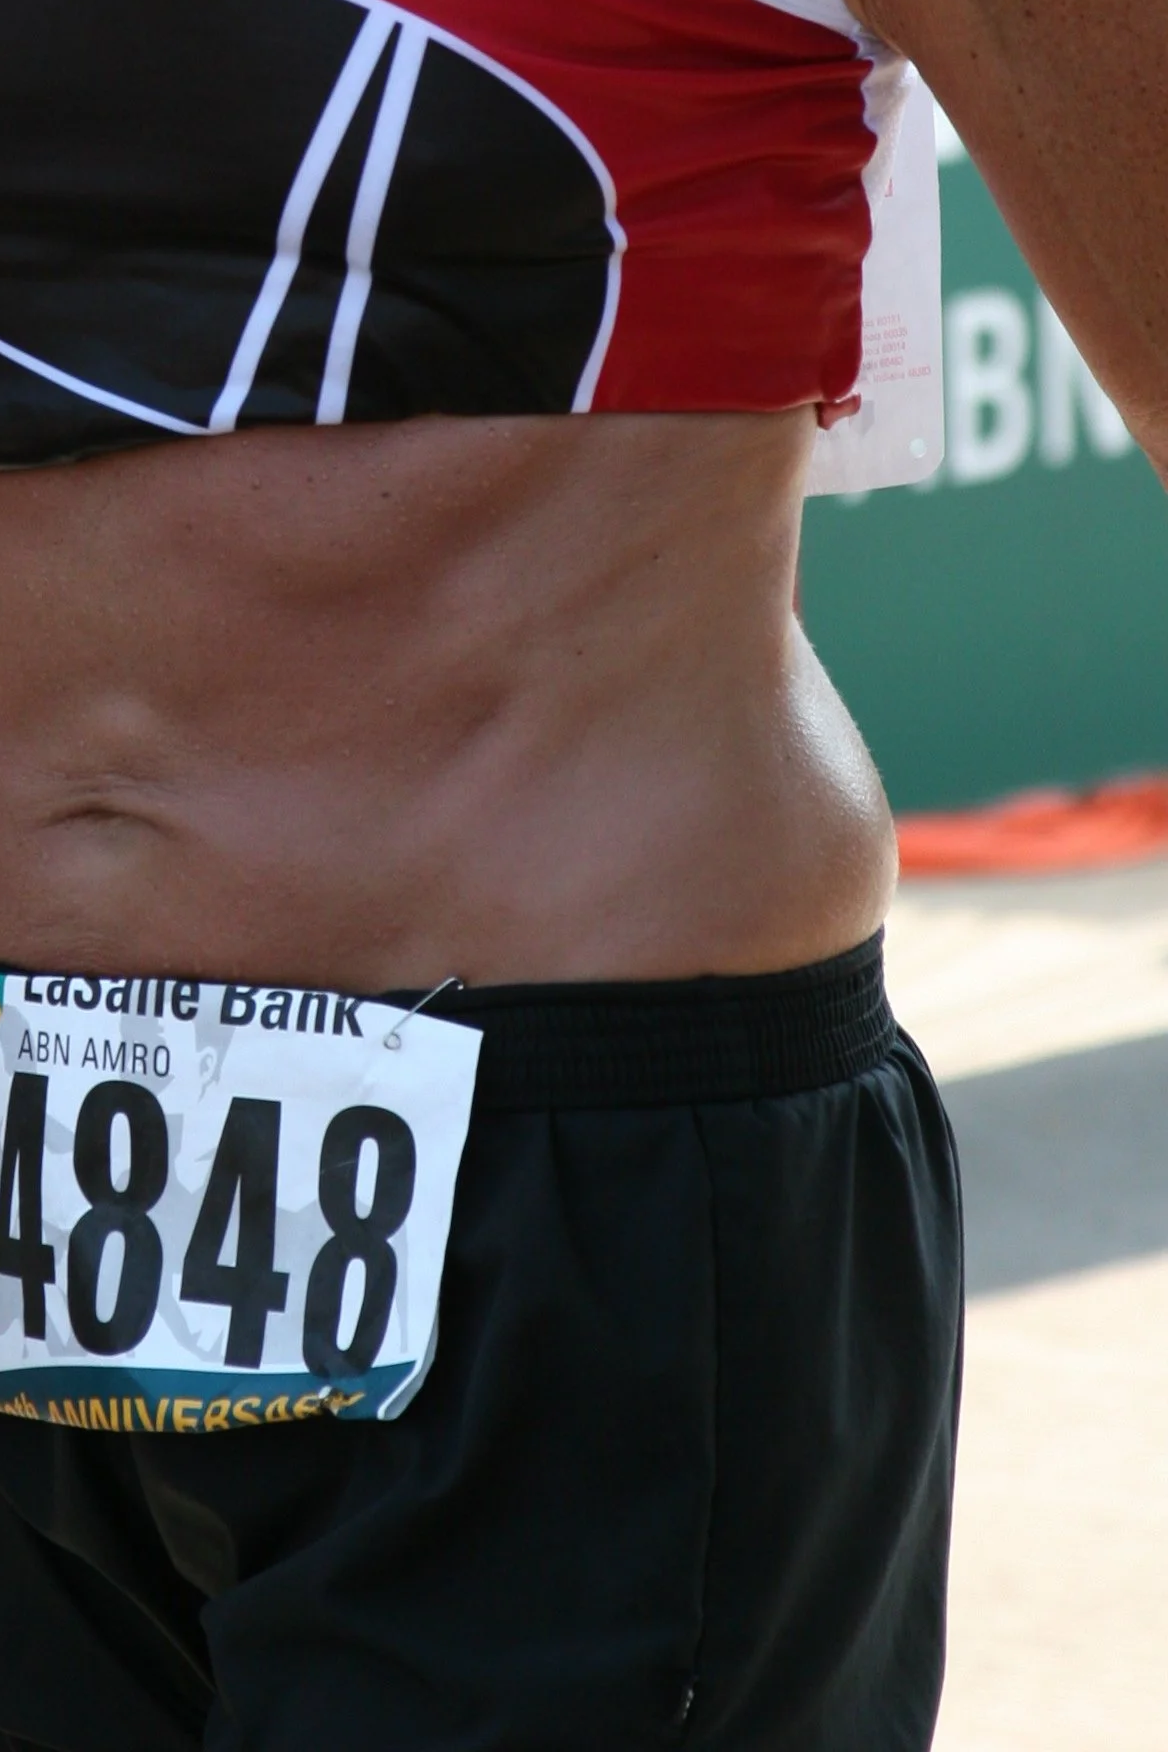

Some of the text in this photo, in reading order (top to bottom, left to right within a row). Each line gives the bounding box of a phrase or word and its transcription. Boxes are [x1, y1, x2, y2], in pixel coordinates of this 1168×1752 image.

[836, 288, 1132, 506] BN
[23, 975, 364, 1038] LaSalle Bank
[17, 1028, 172, 1079] ABN AMRO
